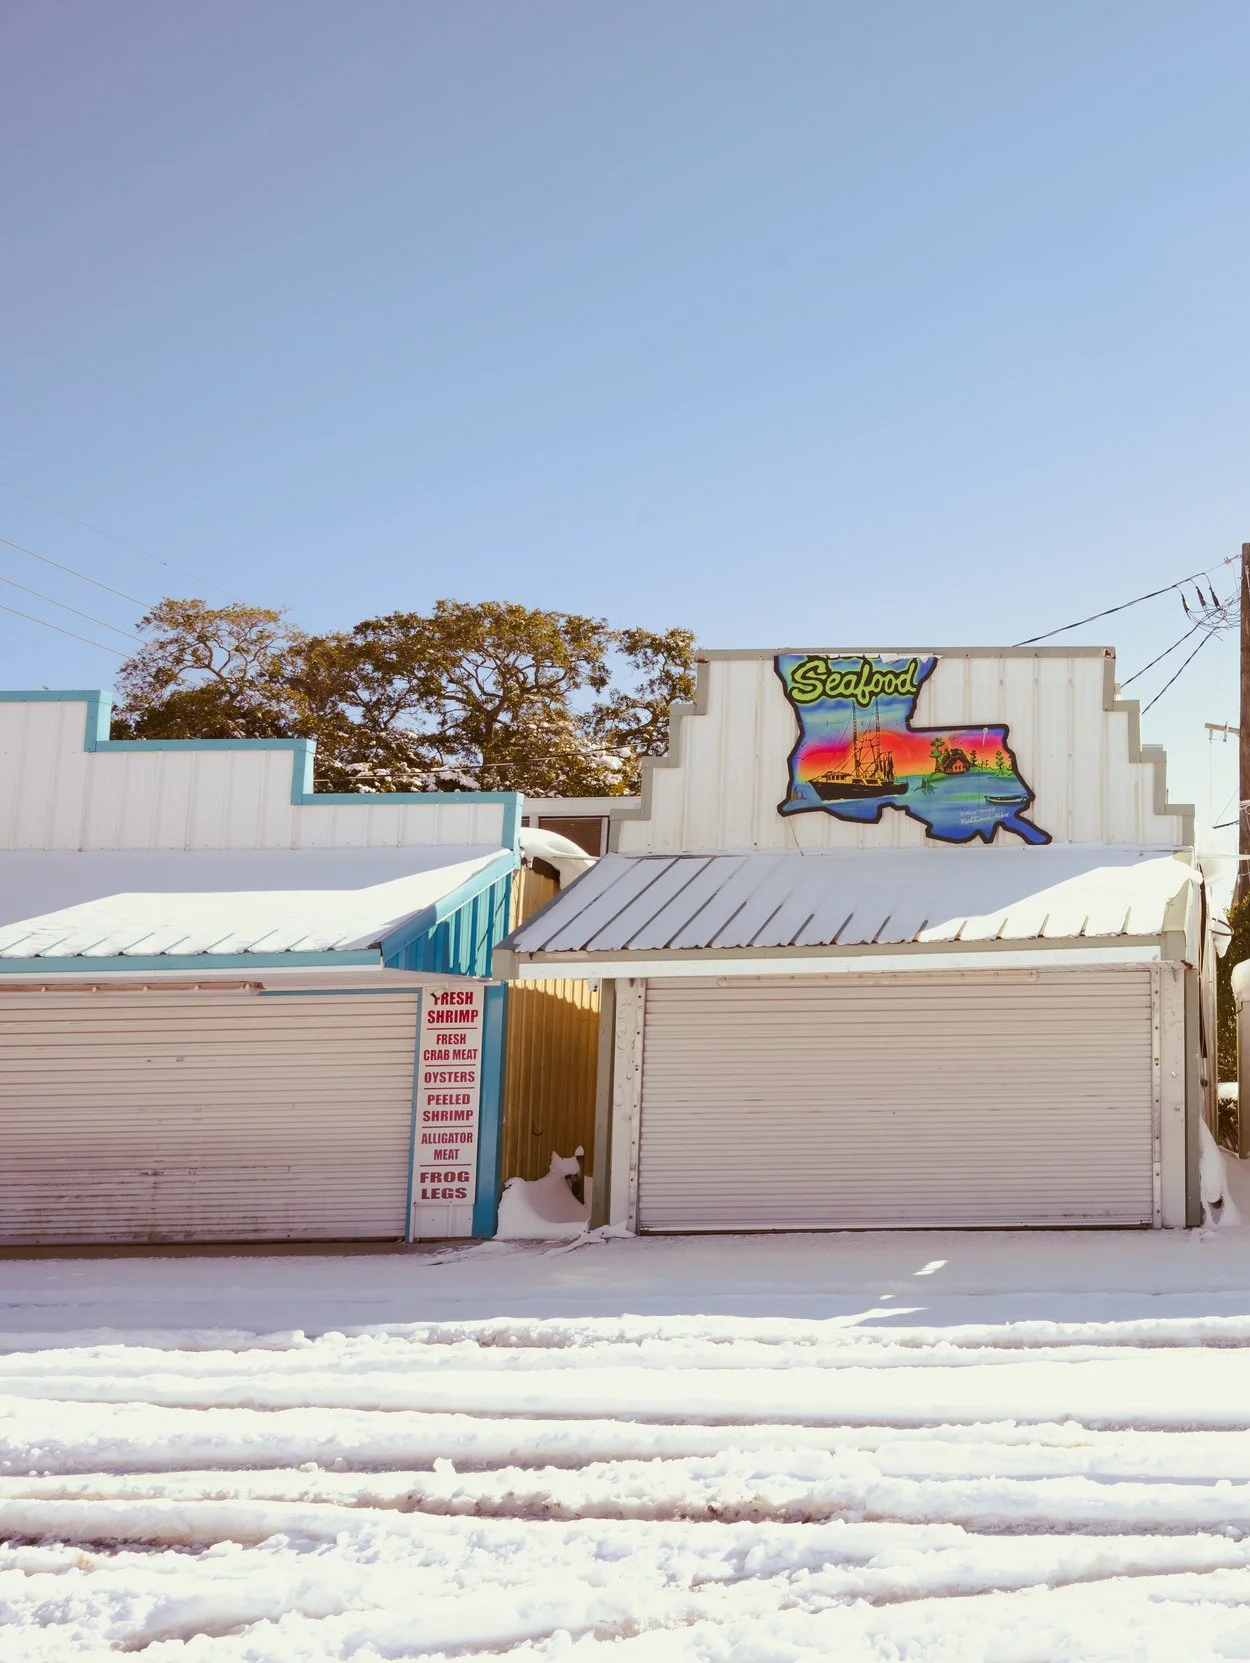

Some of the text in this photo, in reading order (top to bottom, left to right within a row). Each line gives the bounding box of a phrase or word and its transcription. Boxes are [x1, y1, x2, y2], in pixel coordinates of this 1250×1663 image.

[790, 658, 918, 706] Seafood
[427, 1009, 479, 1024] SHRIMP
[436, 1033, 466, 1045] FRESH
[423, 1049, 478, 1061] CRAB MEAT
[424, 1071, 475, 1084] OYSTERS
[427, 1093, 471, 1106] PEELED
[422, 1110, 474, 1122] SHRIMP
[420, 1132, 473, 1145] ALLIGATOR
[433, 1148, 460, 1160] MEAT
[420, 1171, 470, 1184] FROG
[421, 1187, 467, 1200] LEGS
